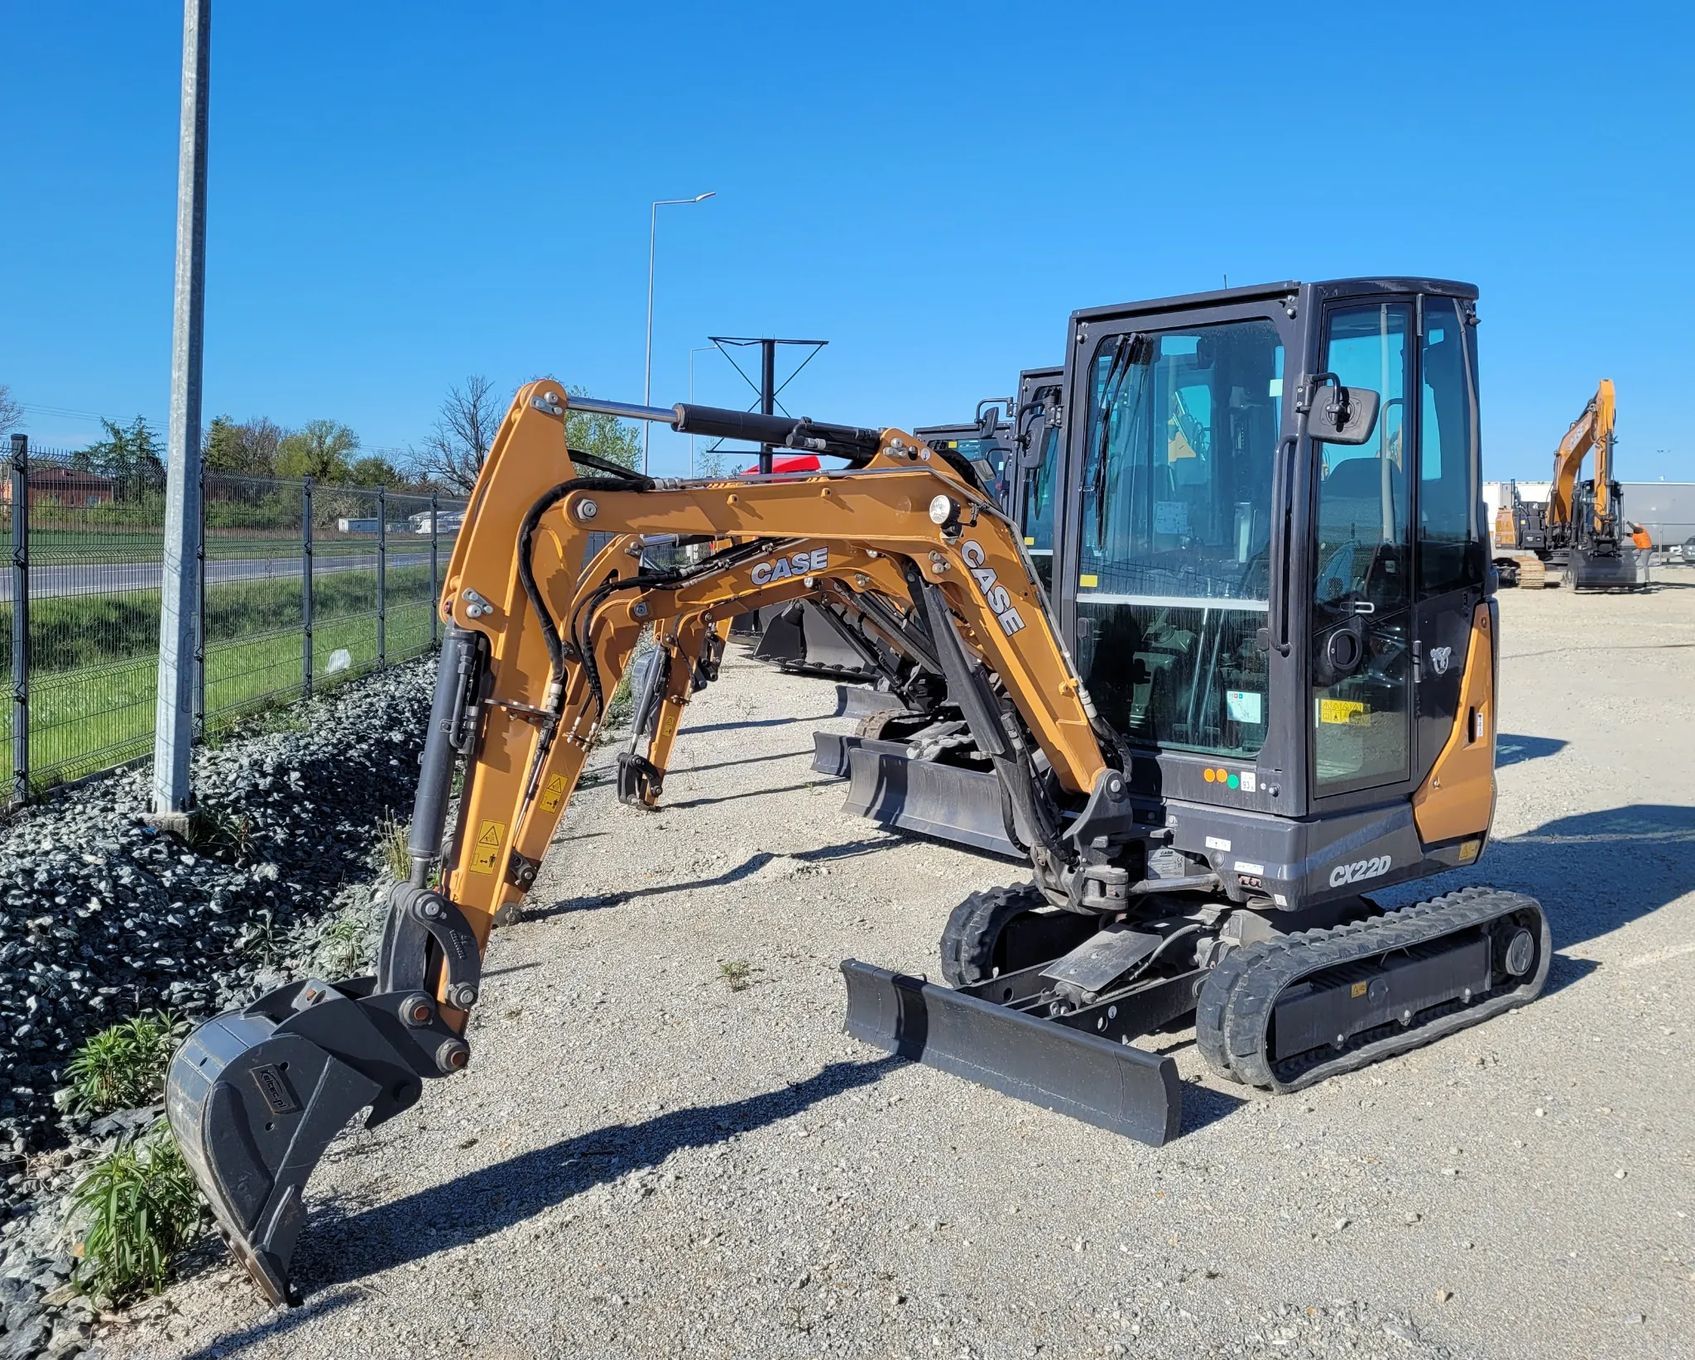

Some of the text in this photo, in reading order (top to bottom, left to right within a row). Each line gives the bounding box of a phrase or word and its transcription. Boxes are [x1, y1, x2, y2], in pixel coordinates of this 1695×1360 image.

[751, 546, 829, 586] CASE
[960, 539, 1026, 637] CASE
[1329, 854, 1392, 888] CX22D
